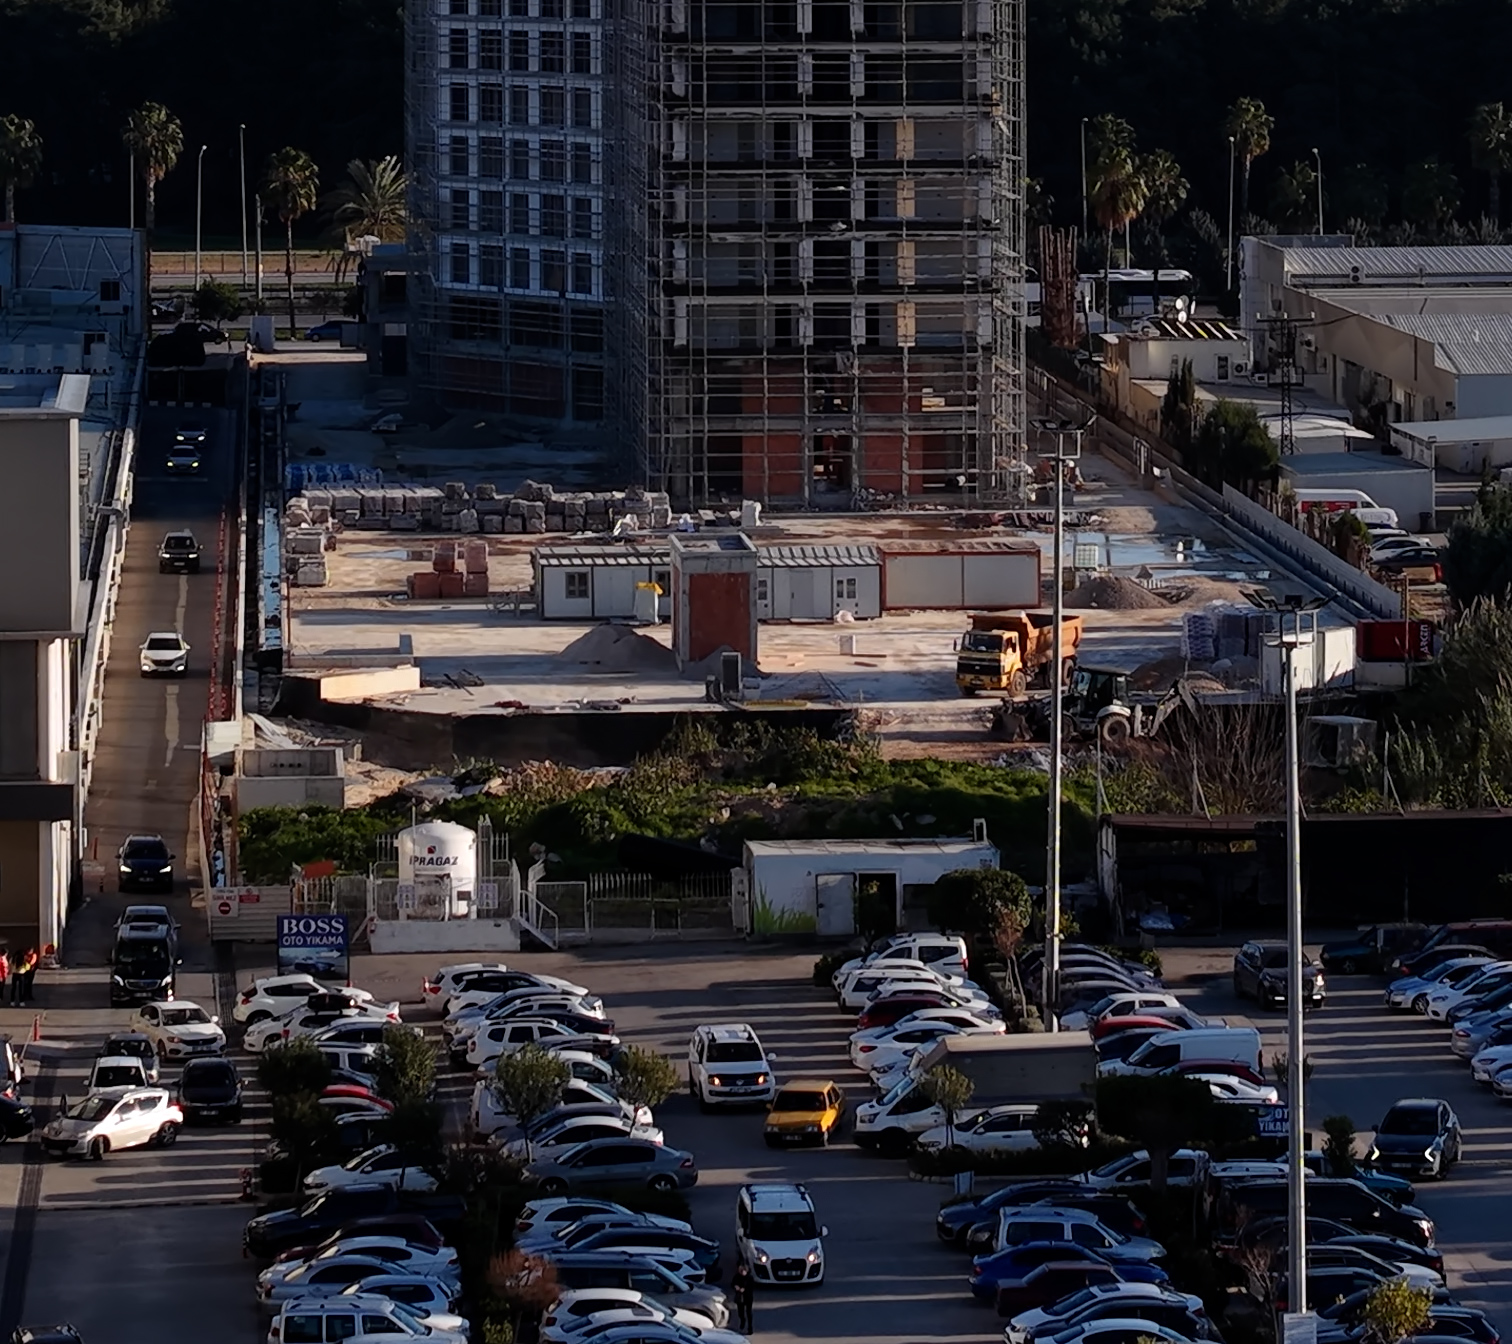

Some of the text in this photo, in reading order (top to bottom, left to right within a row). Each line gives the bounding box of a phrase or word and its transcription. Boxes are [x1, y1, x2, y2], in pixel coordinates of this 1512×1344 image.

[283, 918, 344, 934] BOSS
[282, 936, 343, 945] OTO YIKAMA
[1259, 1121, 1290, 1132] YIKAM
